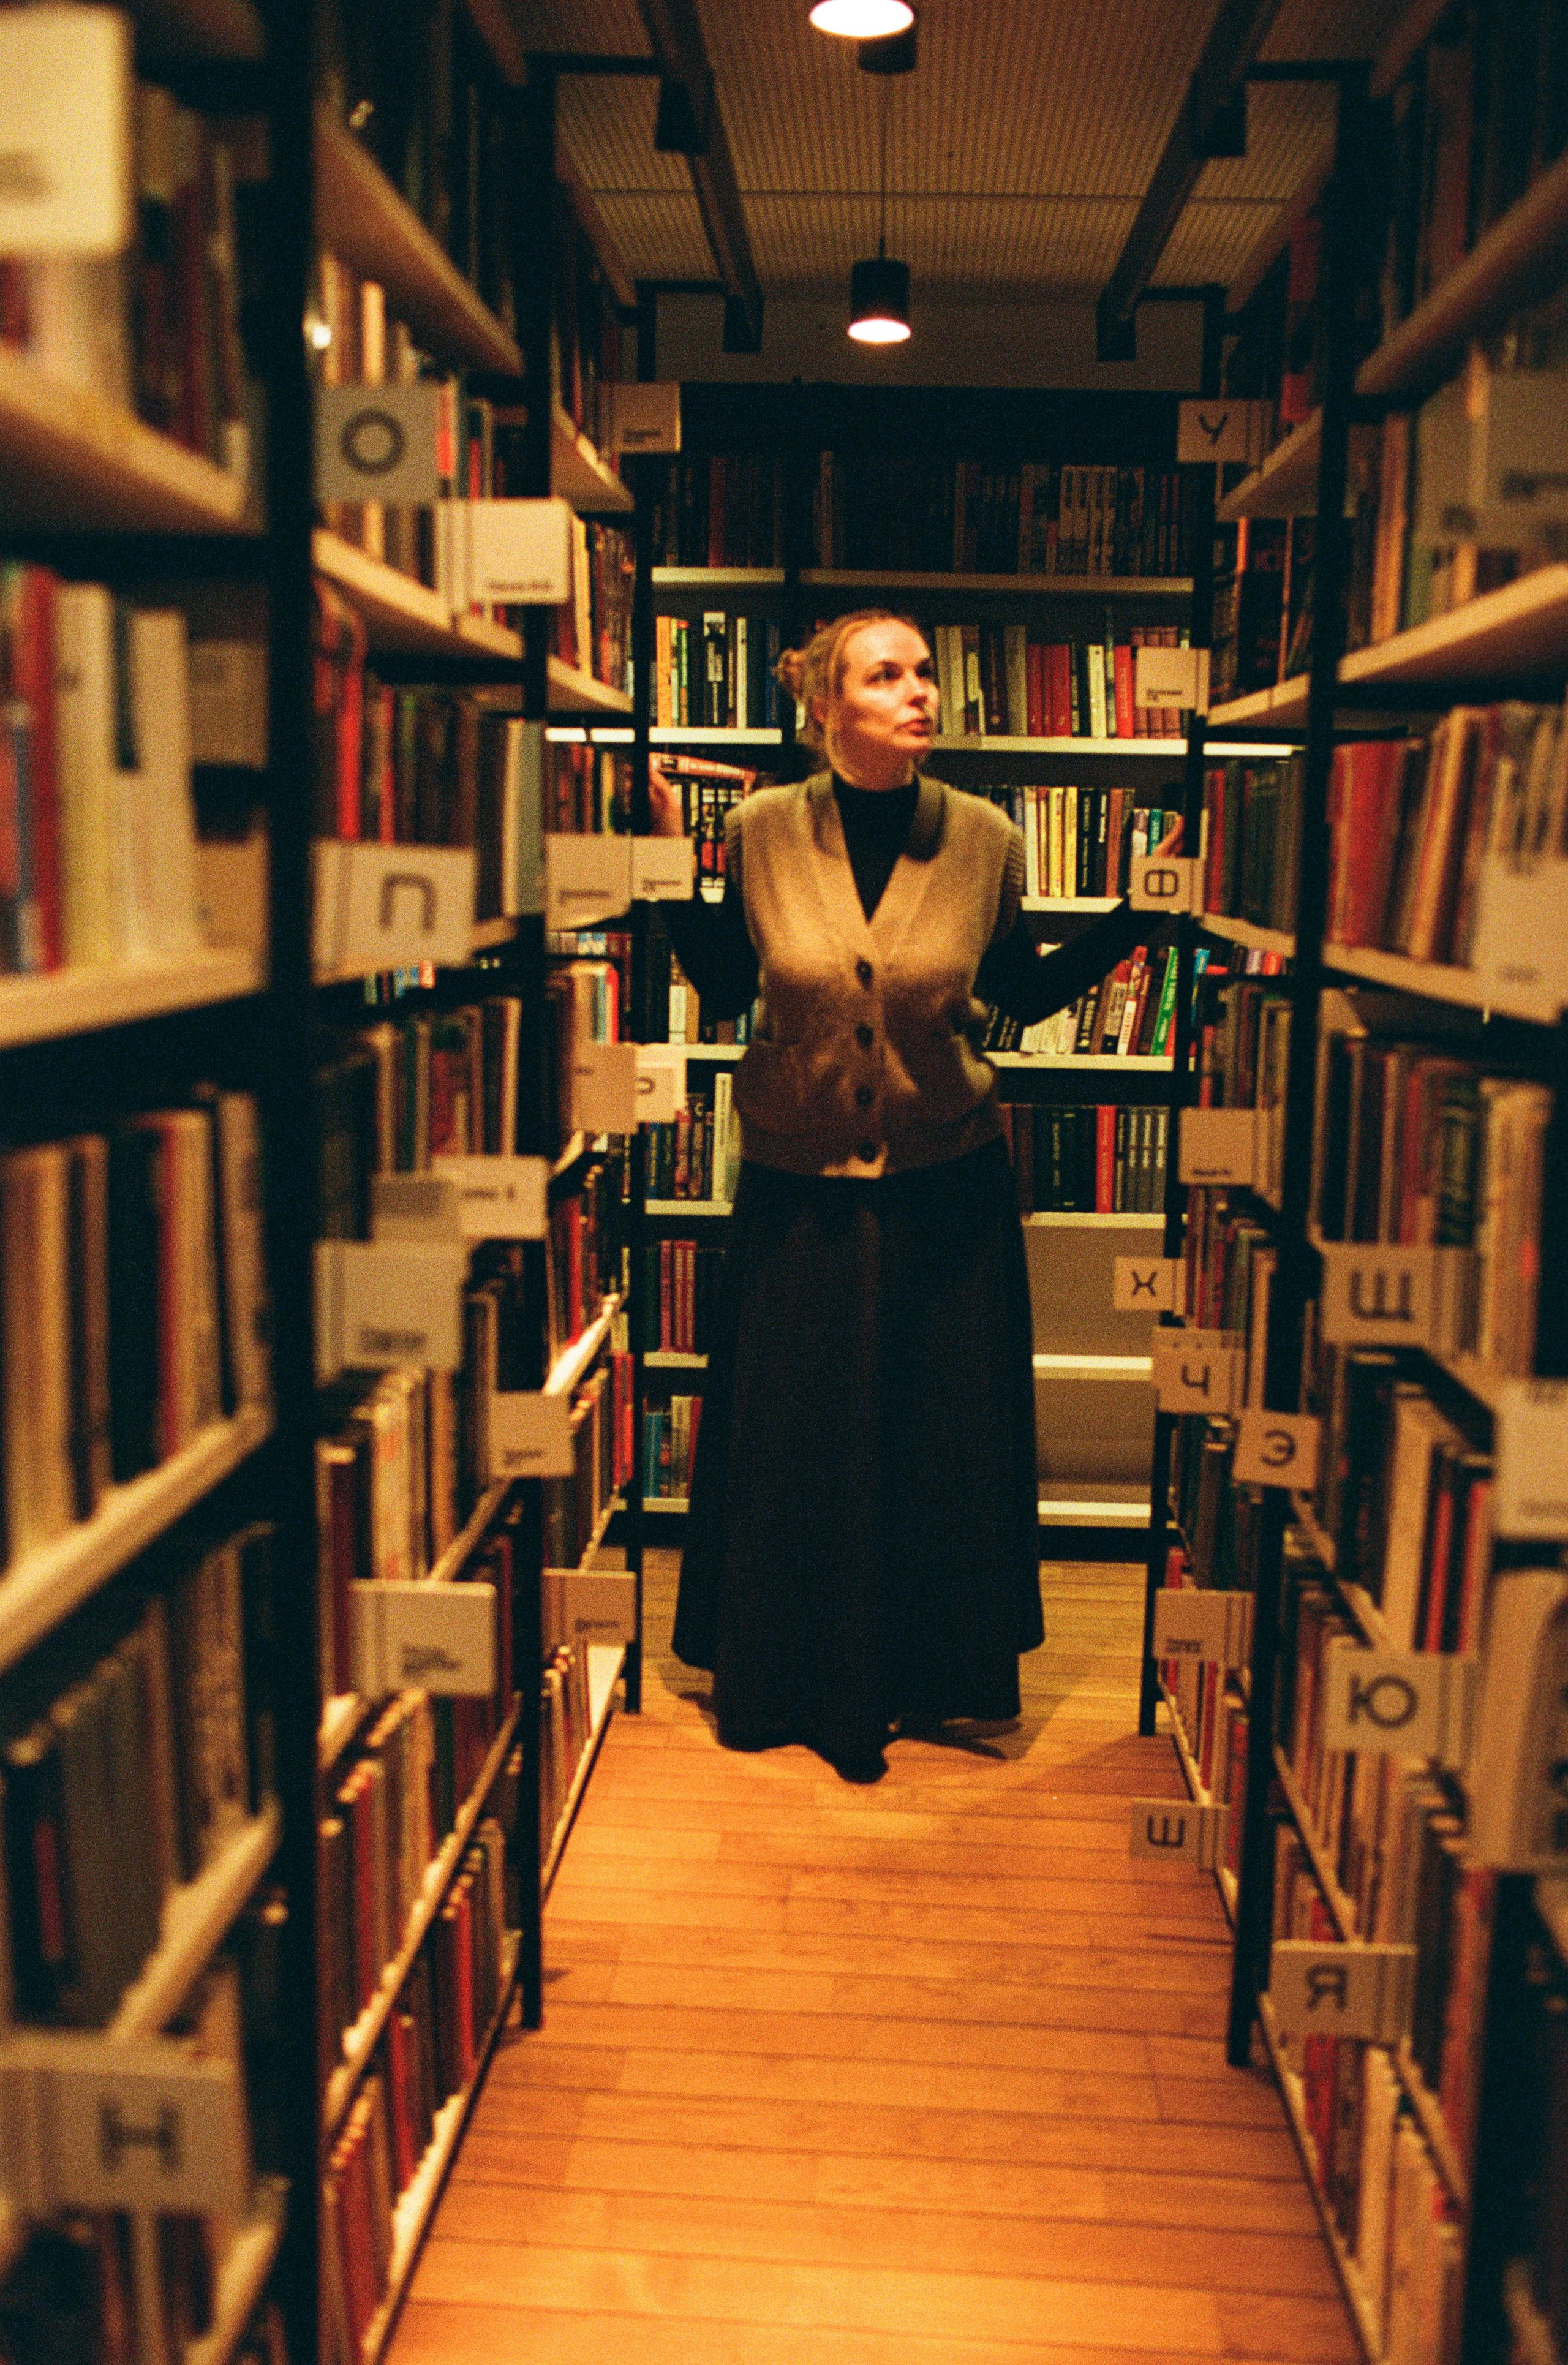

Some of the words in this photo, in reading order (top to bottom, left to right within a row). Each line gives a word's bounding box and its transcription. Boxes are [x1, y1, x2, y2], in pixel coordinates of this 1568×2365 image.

[1198, 412, 1230, 445] У
[1144, 869, 1179, 898] Ф
[379, 872, 437, 933] П
[1131, 1270, 1158, 1297] Х
[1181, 1365, 1210, 1397] Ч
[1262, 1430, 1297, 1467] Э
[1349, 1675, 1418, 1729] Ю
[1307, 1965, 1348, 2011] Я
[99, 2099, 180, 2176] Н
